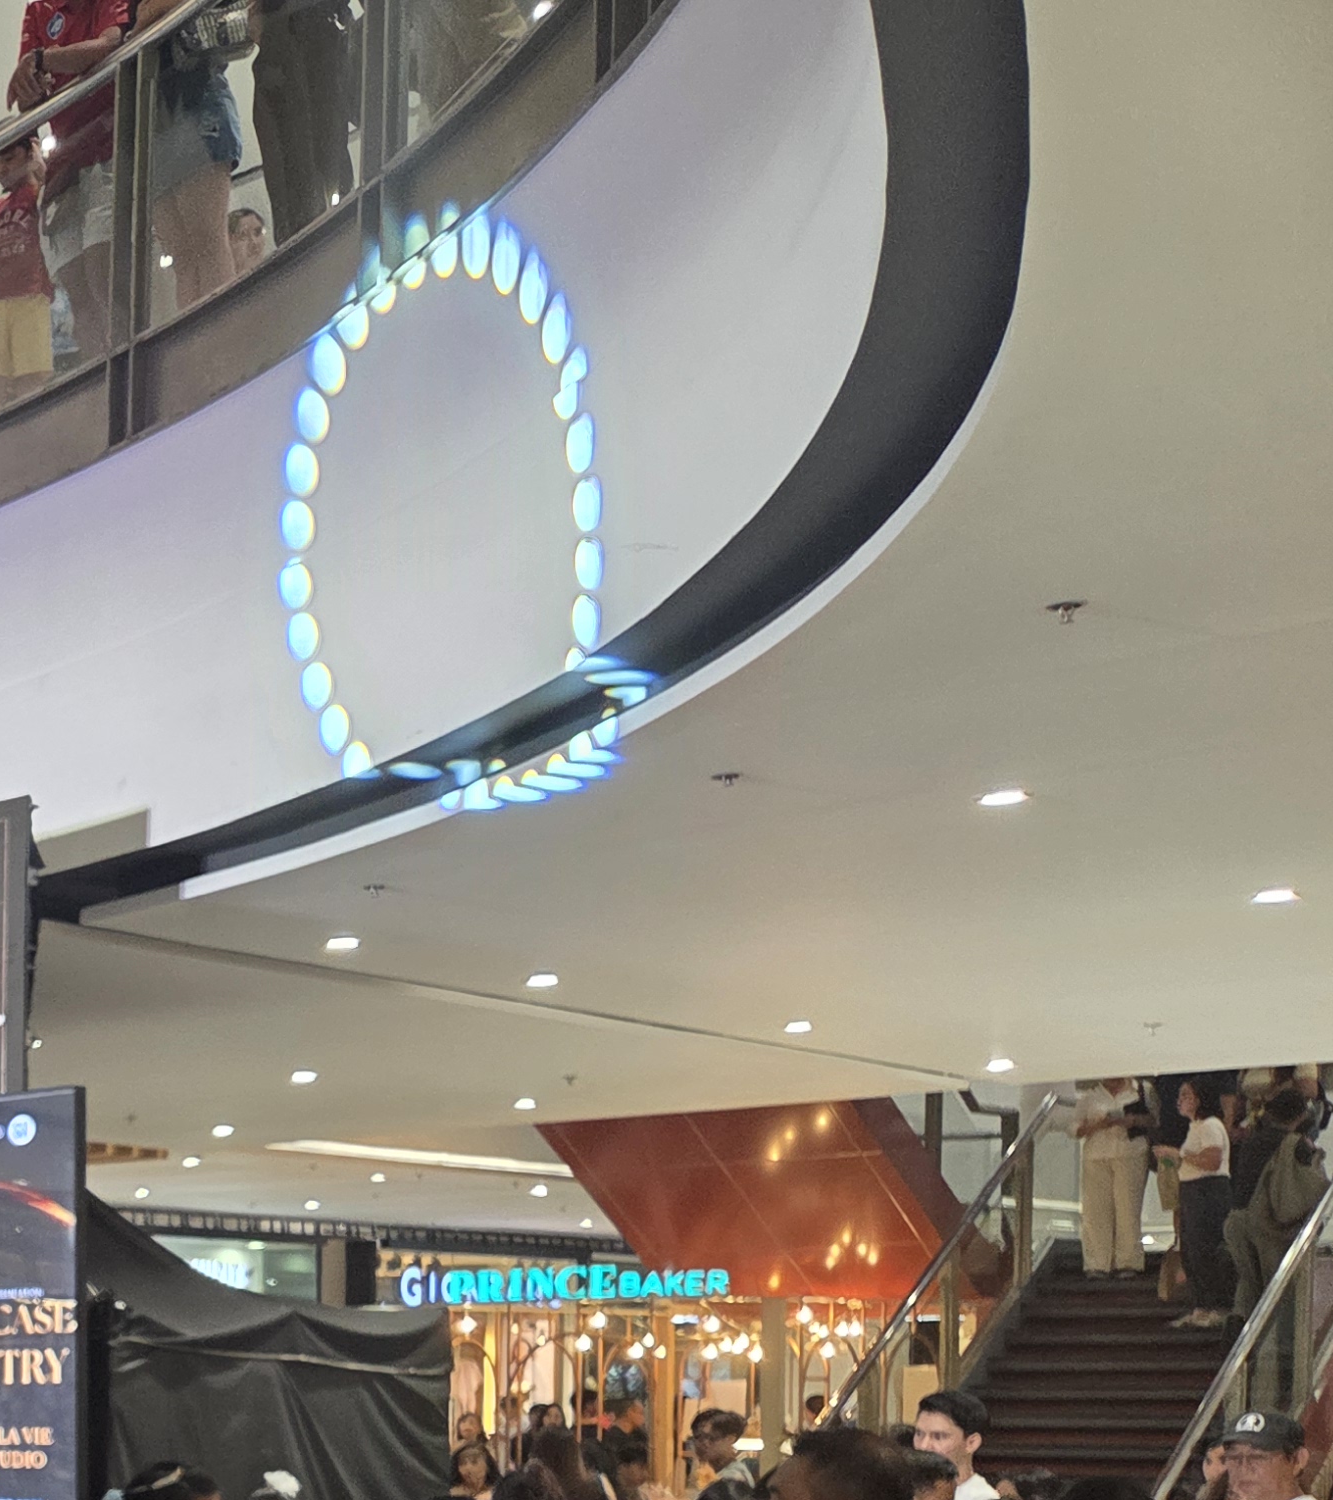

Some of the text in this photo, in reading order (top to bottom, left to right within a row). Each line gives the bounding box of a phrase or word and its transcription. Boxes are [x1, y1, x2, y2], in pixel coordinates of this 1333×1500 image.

[449, 1263, 618, 1305] PRINCE
[618, 1267, 731, 1299] BAKER
[21, 1426, 55, 1446] VIE
